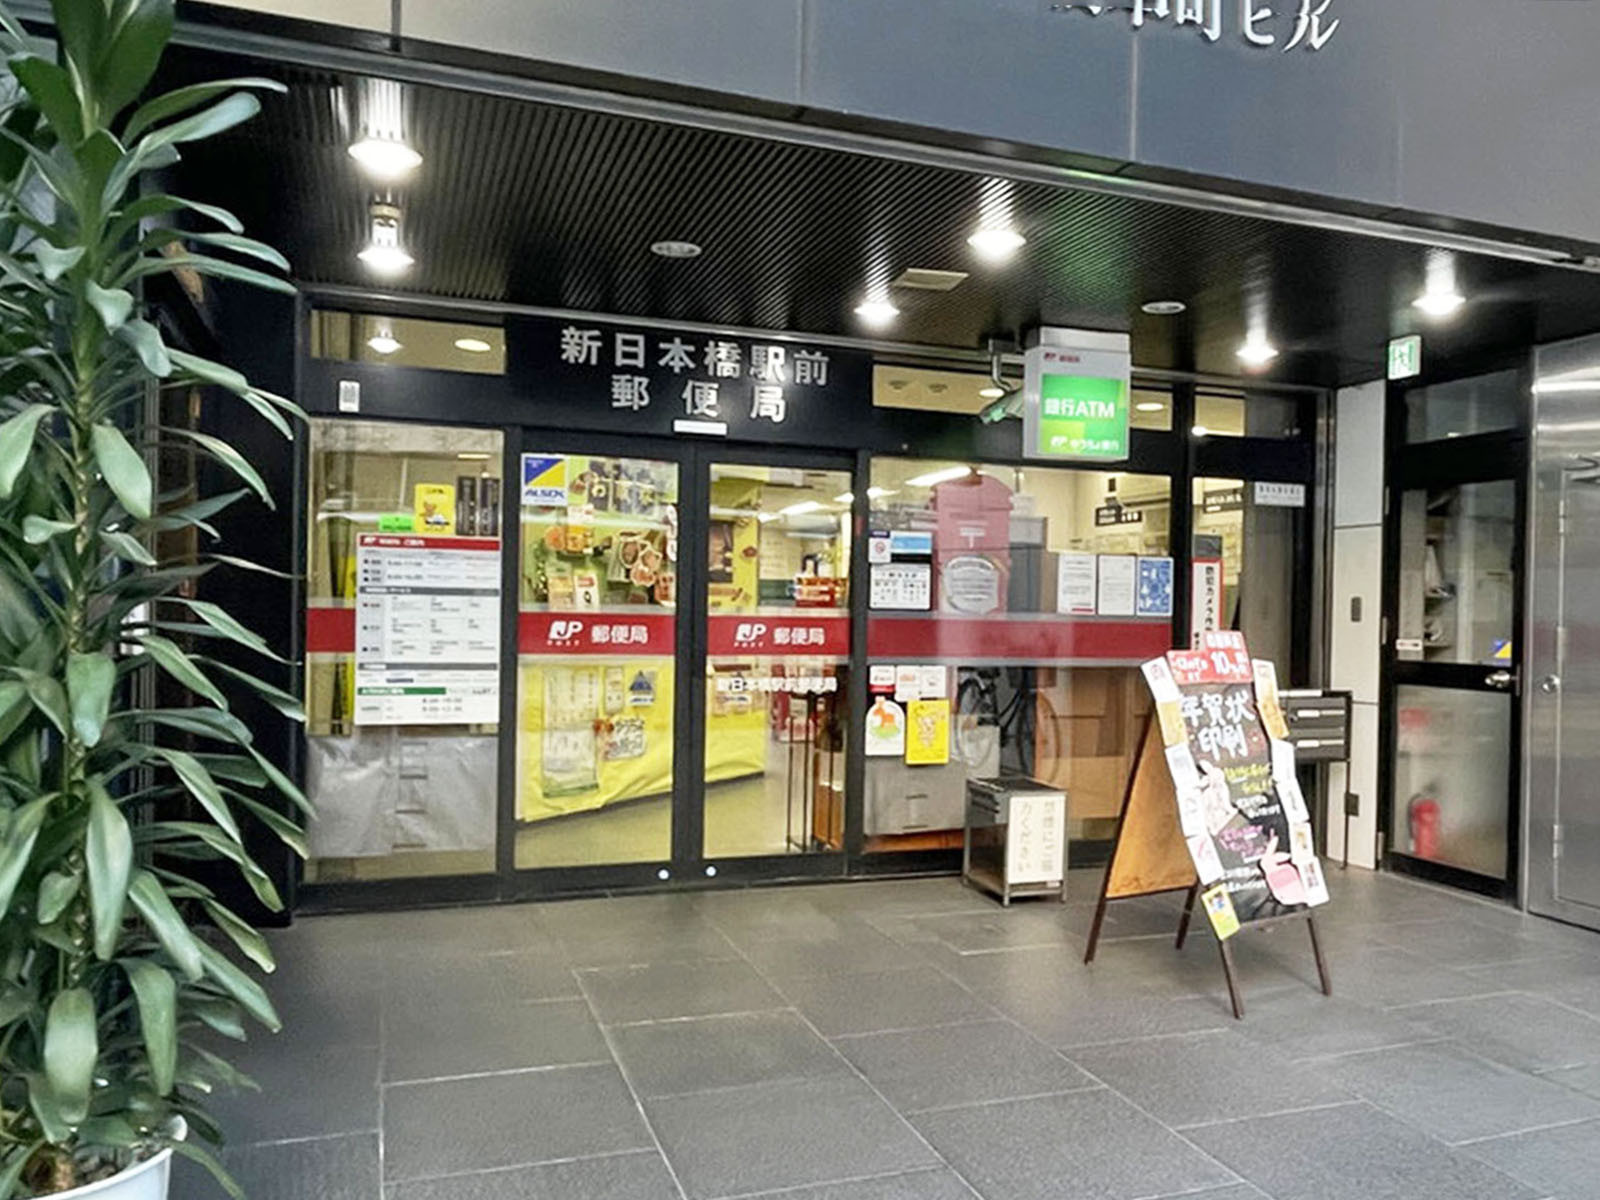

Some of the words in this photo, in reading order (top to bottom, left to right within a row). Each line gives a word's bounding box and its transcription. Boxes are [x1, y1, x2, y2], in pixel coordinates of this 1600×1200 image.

[560, 326, 830, 386] 新日本橋駅前
[611, 374, 787, 423] 郵便局
[591, 625, 649, 644] 郵便局
[773, 627, 825, 645] 郵便局
[1180, 689, 1256, 728] 年賀状
